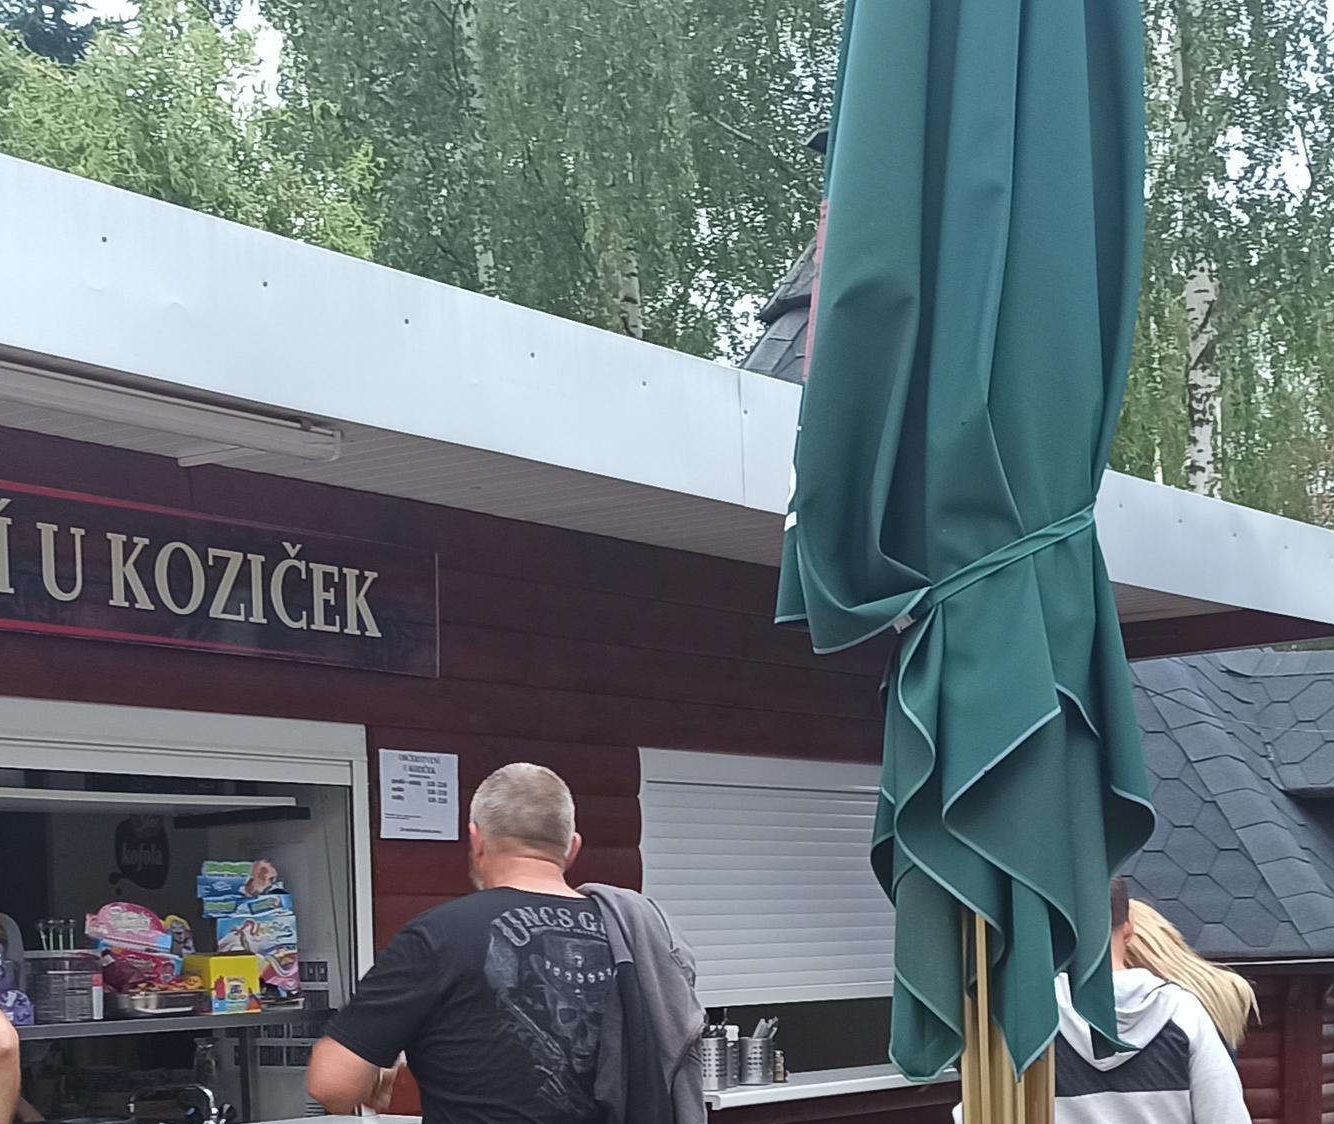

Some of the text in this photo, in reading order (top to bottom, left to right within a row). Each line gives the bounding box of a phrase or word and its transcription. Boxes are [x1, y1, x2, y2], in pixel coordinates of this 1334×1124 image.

[37, 522, 86, 603] U
[107, 541, 383, 639] KOZIČEK
[491, 906, 575, 946] UNCS
